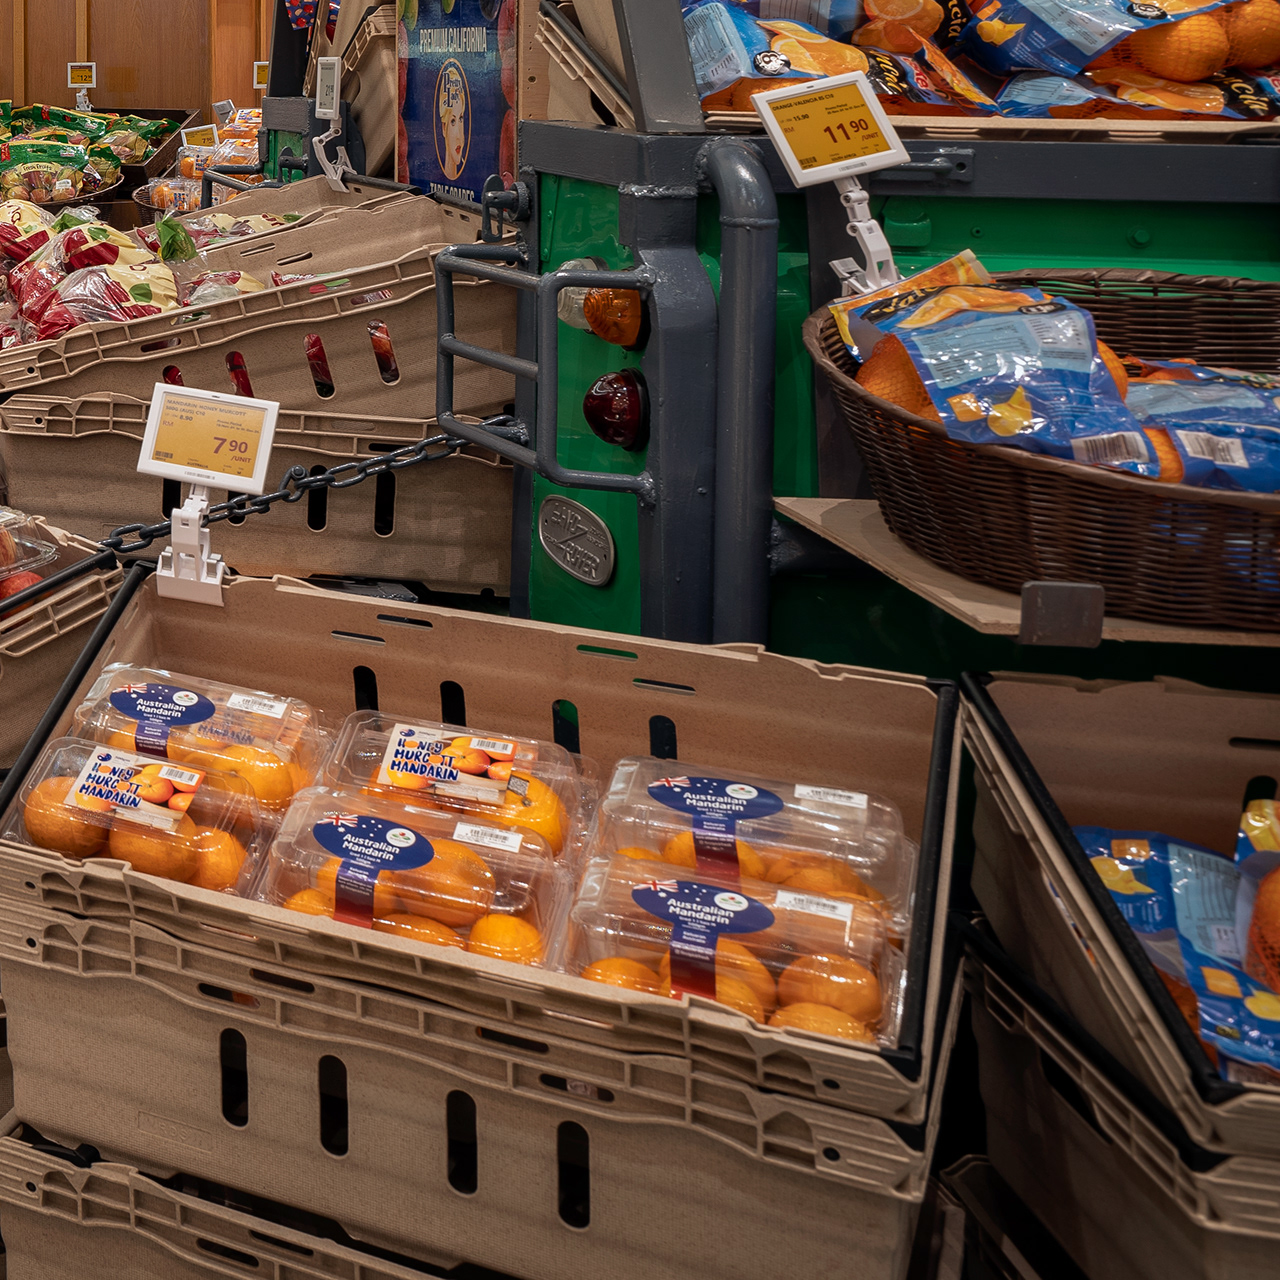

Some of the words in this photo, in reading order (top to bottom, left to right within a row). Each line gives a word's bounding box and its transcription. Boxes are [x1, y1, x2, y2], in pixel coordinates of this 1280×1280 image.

[419, 28, 447, 53] PREMIUM
[448, 27, 487, 53] CALIFORNIA
[443, 72, 461, 93] Pretty
[447, 87, 460, 108] Lady
[772, 97, 818, 111] ORANGE-VALENCIA
[793, 113, 809, 122] 15.90
[784, 126, 795, 134] RM
[861, 132, 879, 141] /UNIT
[872, 286, 939, 314] Vale
[167, 399, 198, 409] MANDARIN
[199, 404, 218, 412] HONEY
[219, 408, 247, 417] MURCOTT
[230, 455, 252, 464] /UNIT
[136, 698, 186, 712] Australian
[136, 704, 182, 718] Mandarin
[390, 760, 459, 781] MANDARIN
[79, 784, 142, 808] MANDARIN
[683, 791, 747, 805] Australian
[686, 798, 744, 812] Mandarin
[342, 833, 400, 855] Australian
[342, 841, 394, 861] Mandarin
[667, 898, 735, 918] Australian
[669, 906, 730, 925] Mandarin
